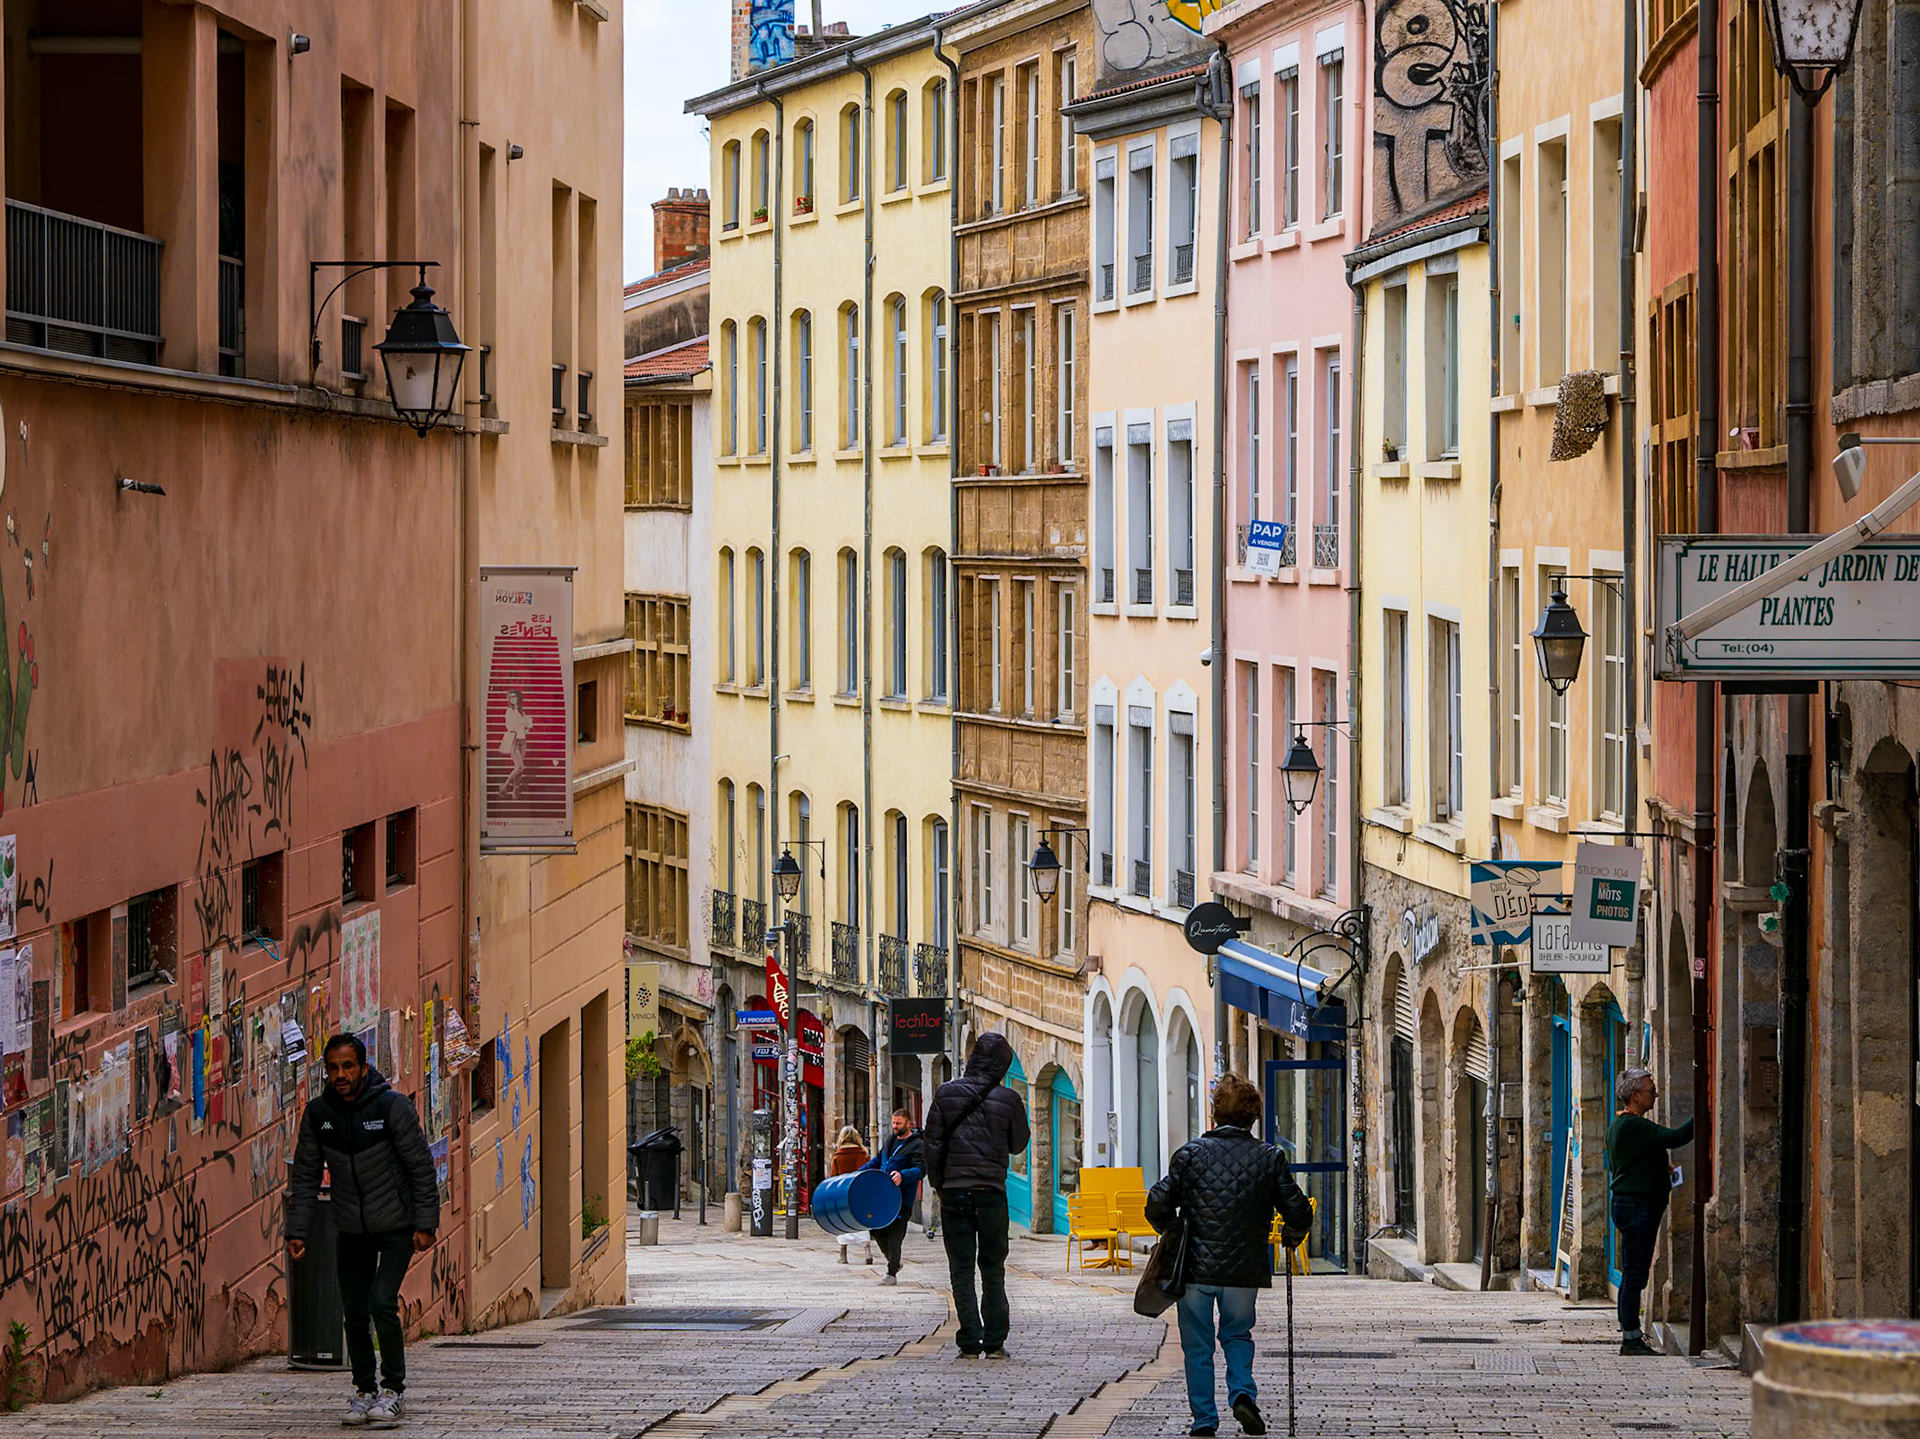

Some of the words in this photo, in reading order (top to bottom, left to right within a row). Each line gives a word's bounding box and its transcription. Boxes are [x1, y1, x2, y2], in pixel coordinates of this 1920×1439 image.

[1252, 523, 1282, 537] PAP
[1257, 539, 1280, 549] VENDRE
[1697, 554, 1720, 582] LE
[1818, 554, 1888, 588] JARDIN
[1759, 596, 1835, 626] PLANTES
[1577, 864, 1610, 876] STUDIO
[1614, 868, 1629, 878] 104
[1597, 887, 1622, 902] MOTS
[1596, 904, 1630, 919] PHOTOS
[1190, 920, 1232, 938] Quartier
[770, 972, 789, 1020] TABAC
[631, 1012, 656, 1020] VINICA
